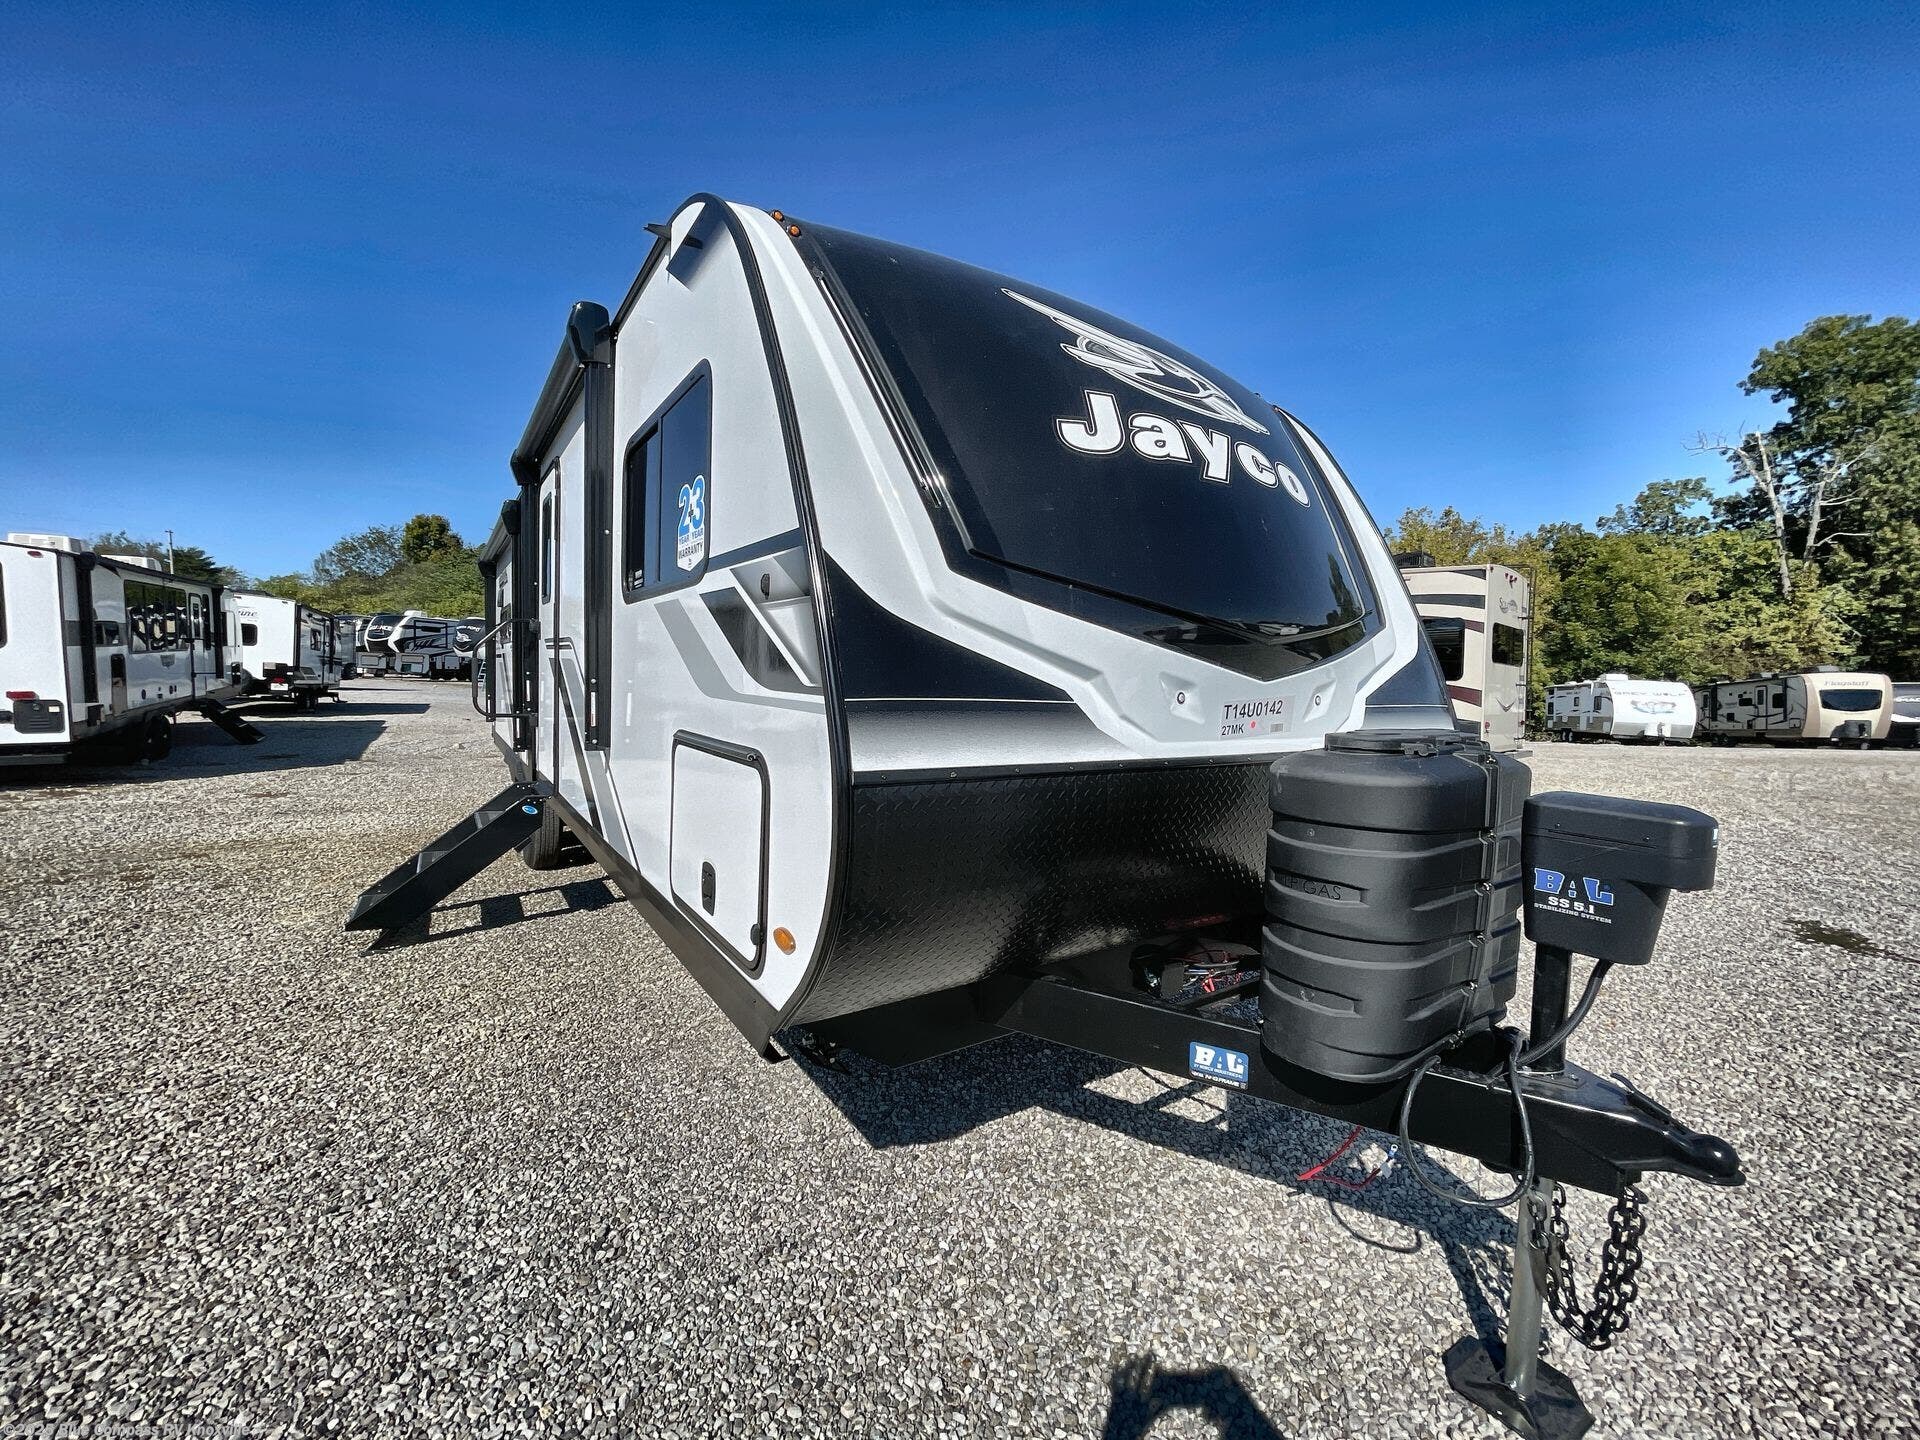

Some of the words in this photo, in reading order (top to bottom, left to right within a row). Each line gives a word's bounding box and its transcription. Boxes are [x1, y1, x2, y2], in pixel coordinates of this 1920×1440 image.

[1055, 388, 1311, 508] Jayco
[678, 541, 704, 560] WARRANTY
[1224, 699, 1284, 720] T14U0142
[1221, 723, 1245, 736] 27MK
[1547, 896, 1569, 908] SS
[1534, 903, 1579, 916] STABILIZING
[1581, 913, 1612, 924] SYSTEM
